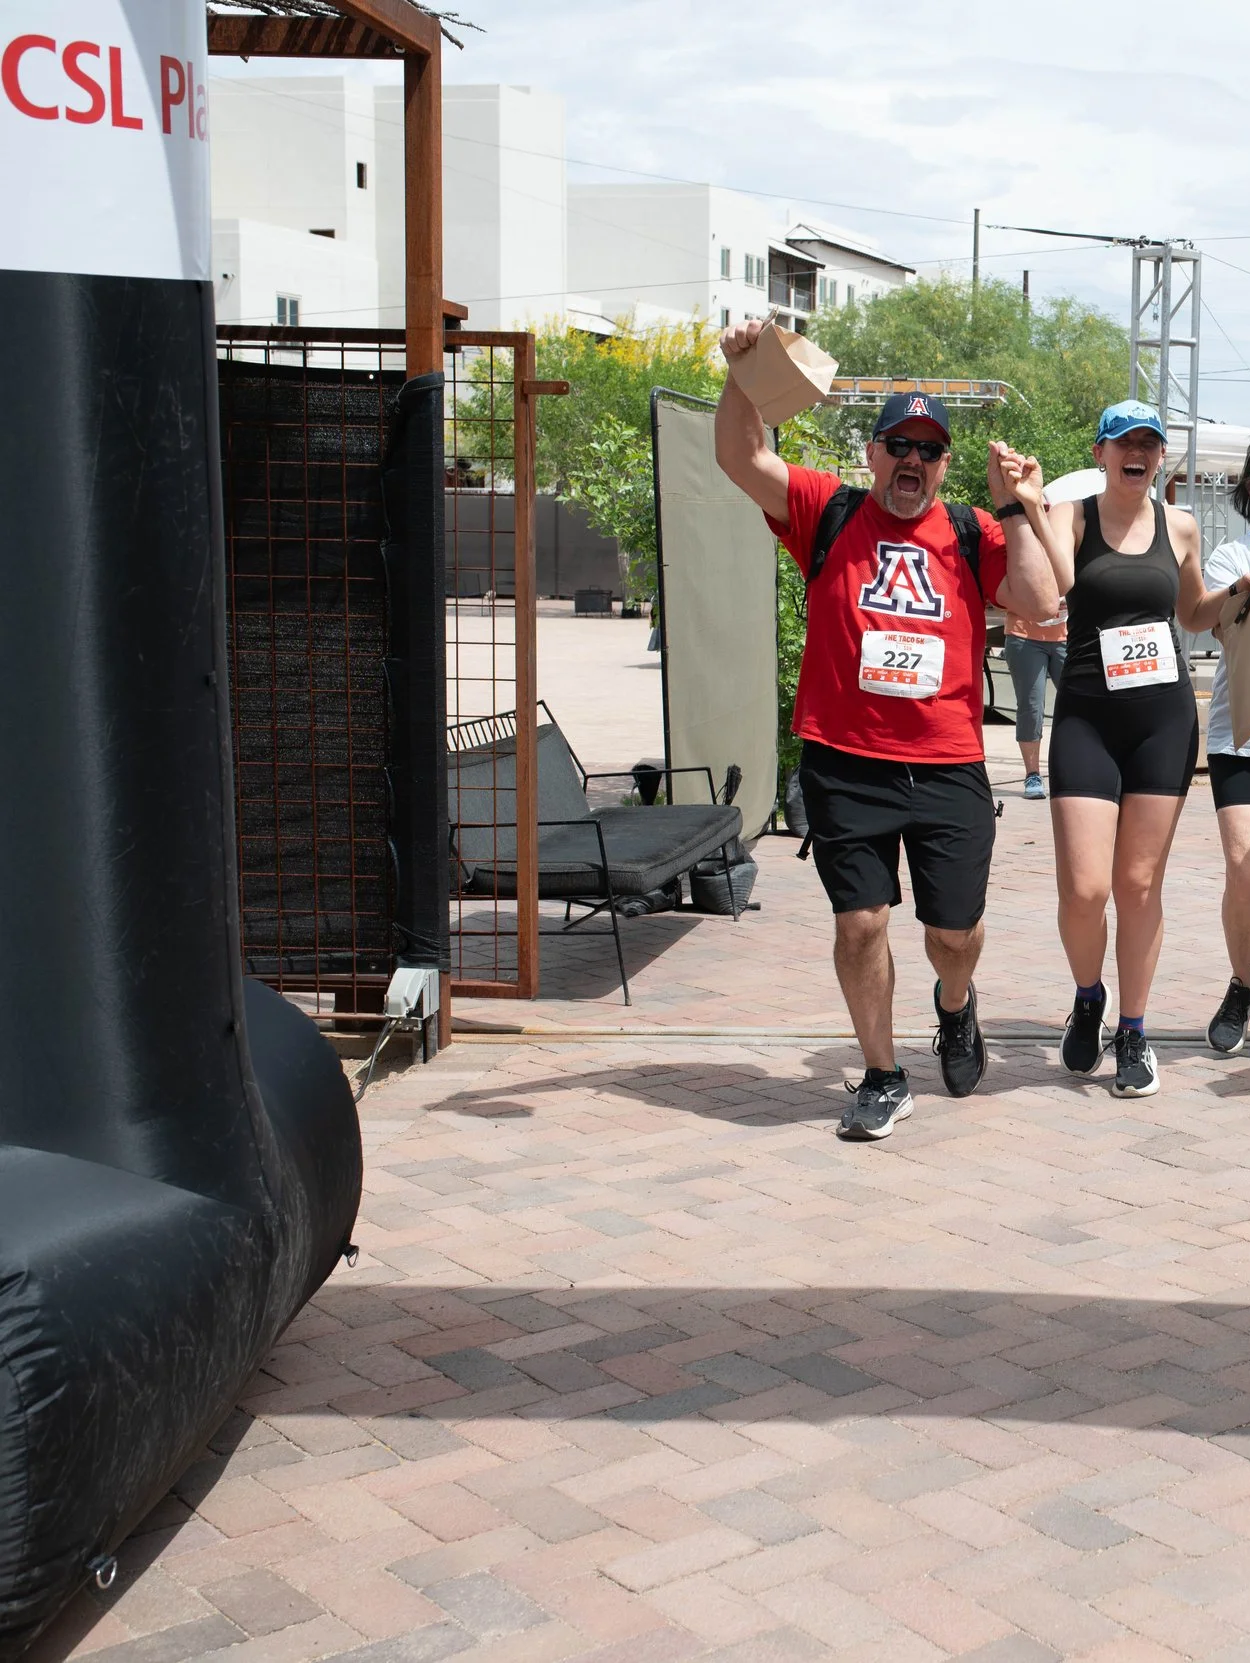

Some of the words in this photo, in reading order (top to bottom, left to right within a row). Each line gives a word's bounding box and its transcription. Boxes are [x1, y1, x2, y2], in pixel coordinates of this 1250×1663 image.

[1, 34, 143, 130] CSL
[160, 55, 208, 141] Pla
[904, 396, 932, 418] A
[858, 541, 945, 623] A
[899, 635, 915, 643] TACO
[883, 650, 923, 670] 227
[1122, 641, 1159, 661] 228
